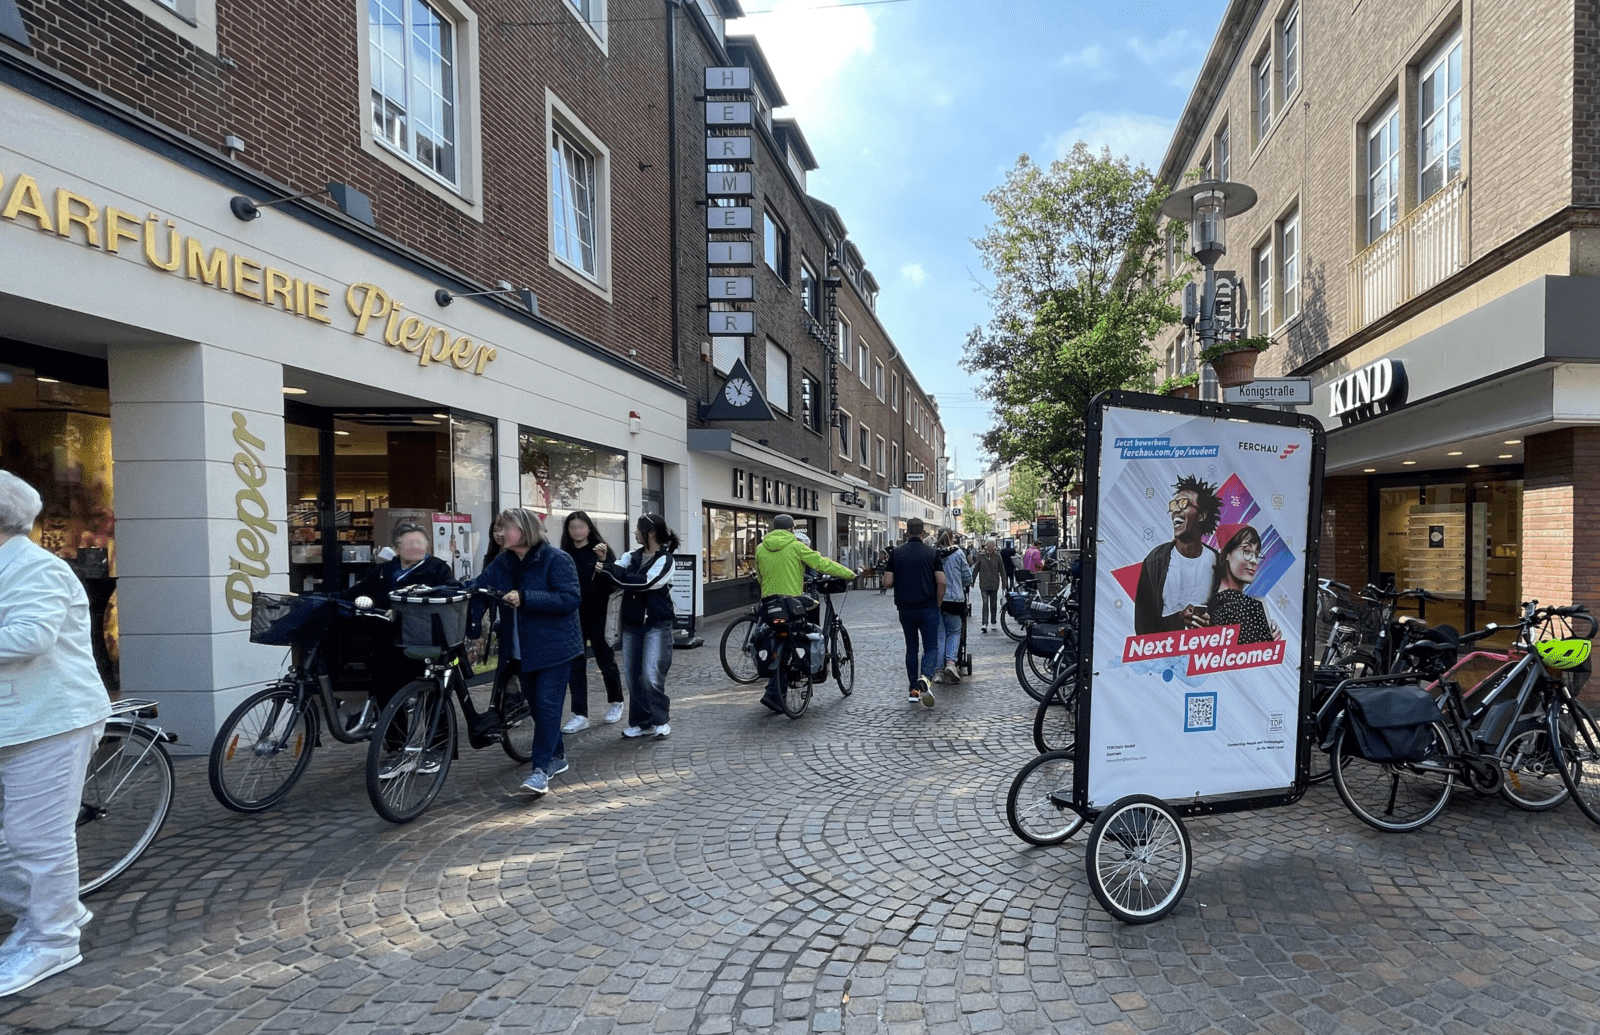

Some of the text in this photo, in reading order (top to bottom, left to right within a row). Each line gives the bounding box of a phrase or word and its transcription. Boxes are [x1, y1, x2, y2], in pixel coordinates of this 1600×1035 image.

[721, 70, 739, 331] HERMEIER
[0, 171, 497, 376] ARFÜMERIE Pieper
[1239, 384, 1295, 399] Königstraße
[1328, 358, 1393, 418] KIND
[1115, 438, 1169, 447] Jetzt bewerben:
[1122, 447, 1217, 458] ferchau.com/go/student
[1238, 442, 1278, 453] FERCHAU
[733, 468, 819, 511] HERMEIER
[225, 410, 278, 622] Pieper
[1128, 627, 1235, 658] Next Level?
[1193, 644, 1281, 671] Welcome!
[1270, 719, 1283, 727] TOP
